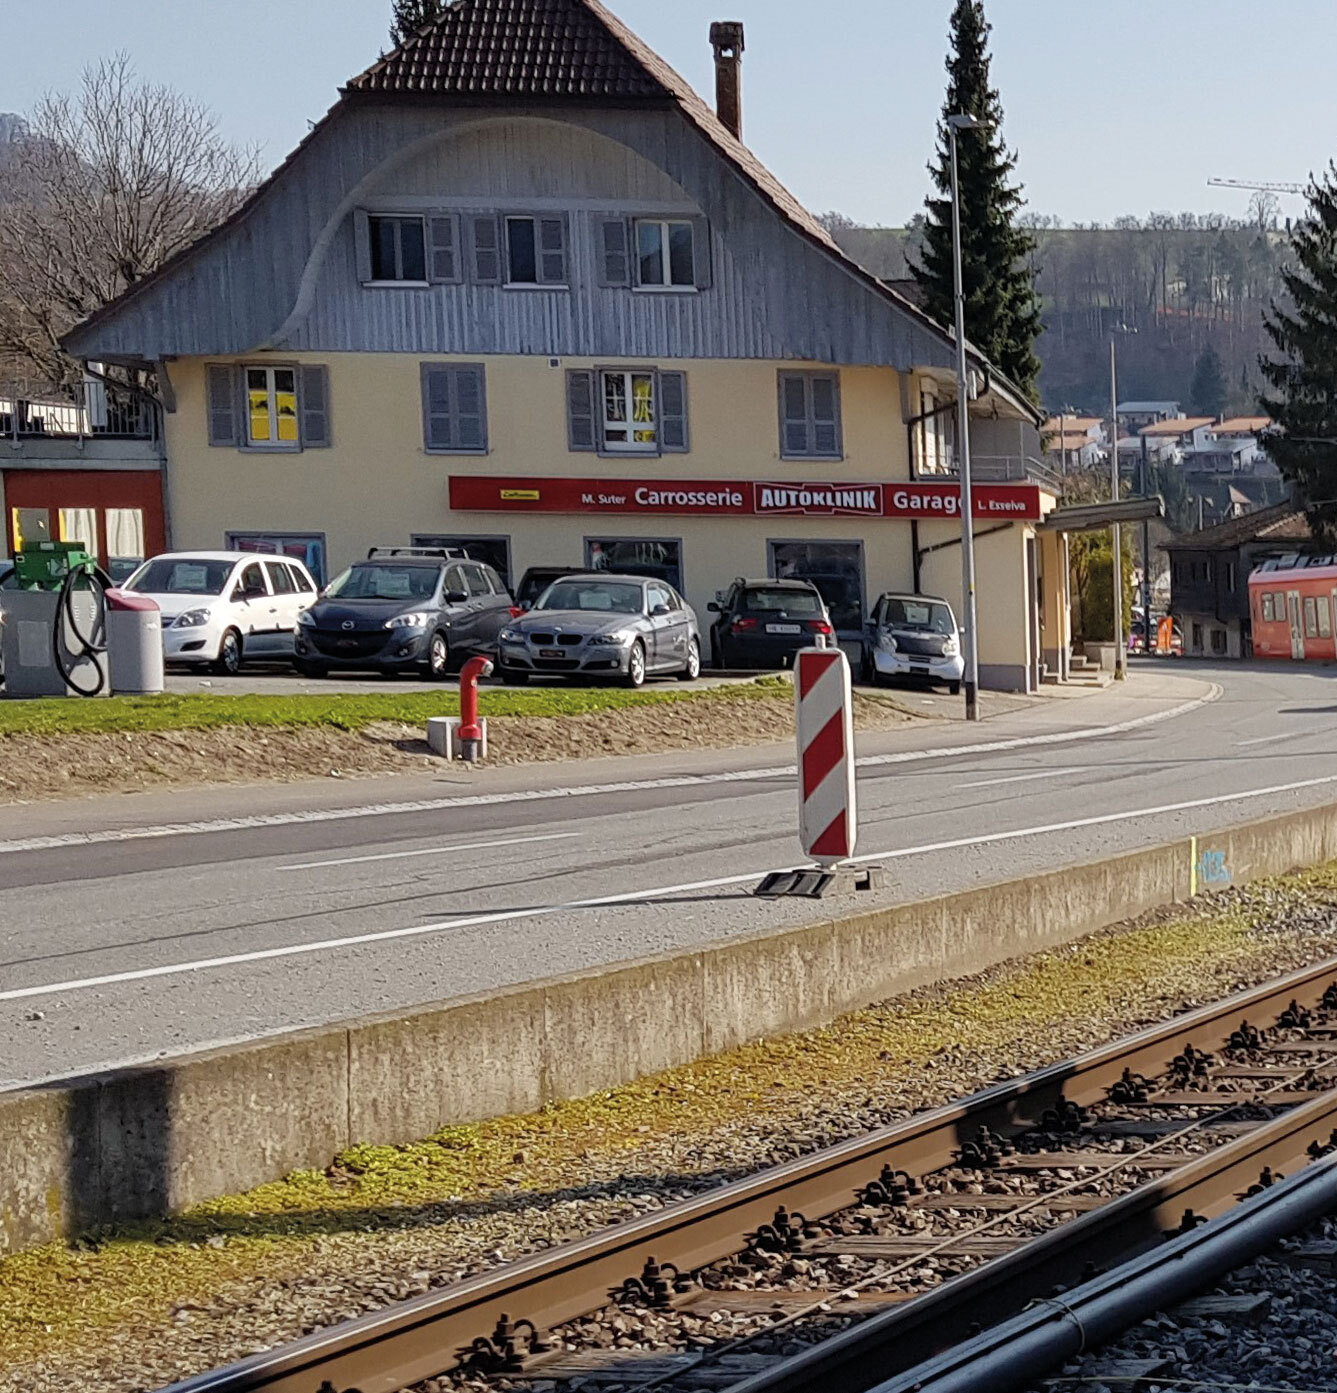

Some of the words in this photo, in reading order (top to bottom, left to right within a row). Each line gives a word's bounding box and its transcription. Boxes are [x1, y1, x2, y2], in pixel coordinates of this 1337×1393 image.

[581, 493, 596, 504] M.
[598, 494, 626, 505] Suter
[634, 487, 743, 507] Carrosserie
[760, 488, 876, 510] AUTOKLINIK
[893, 491, 961, 513] Garag
